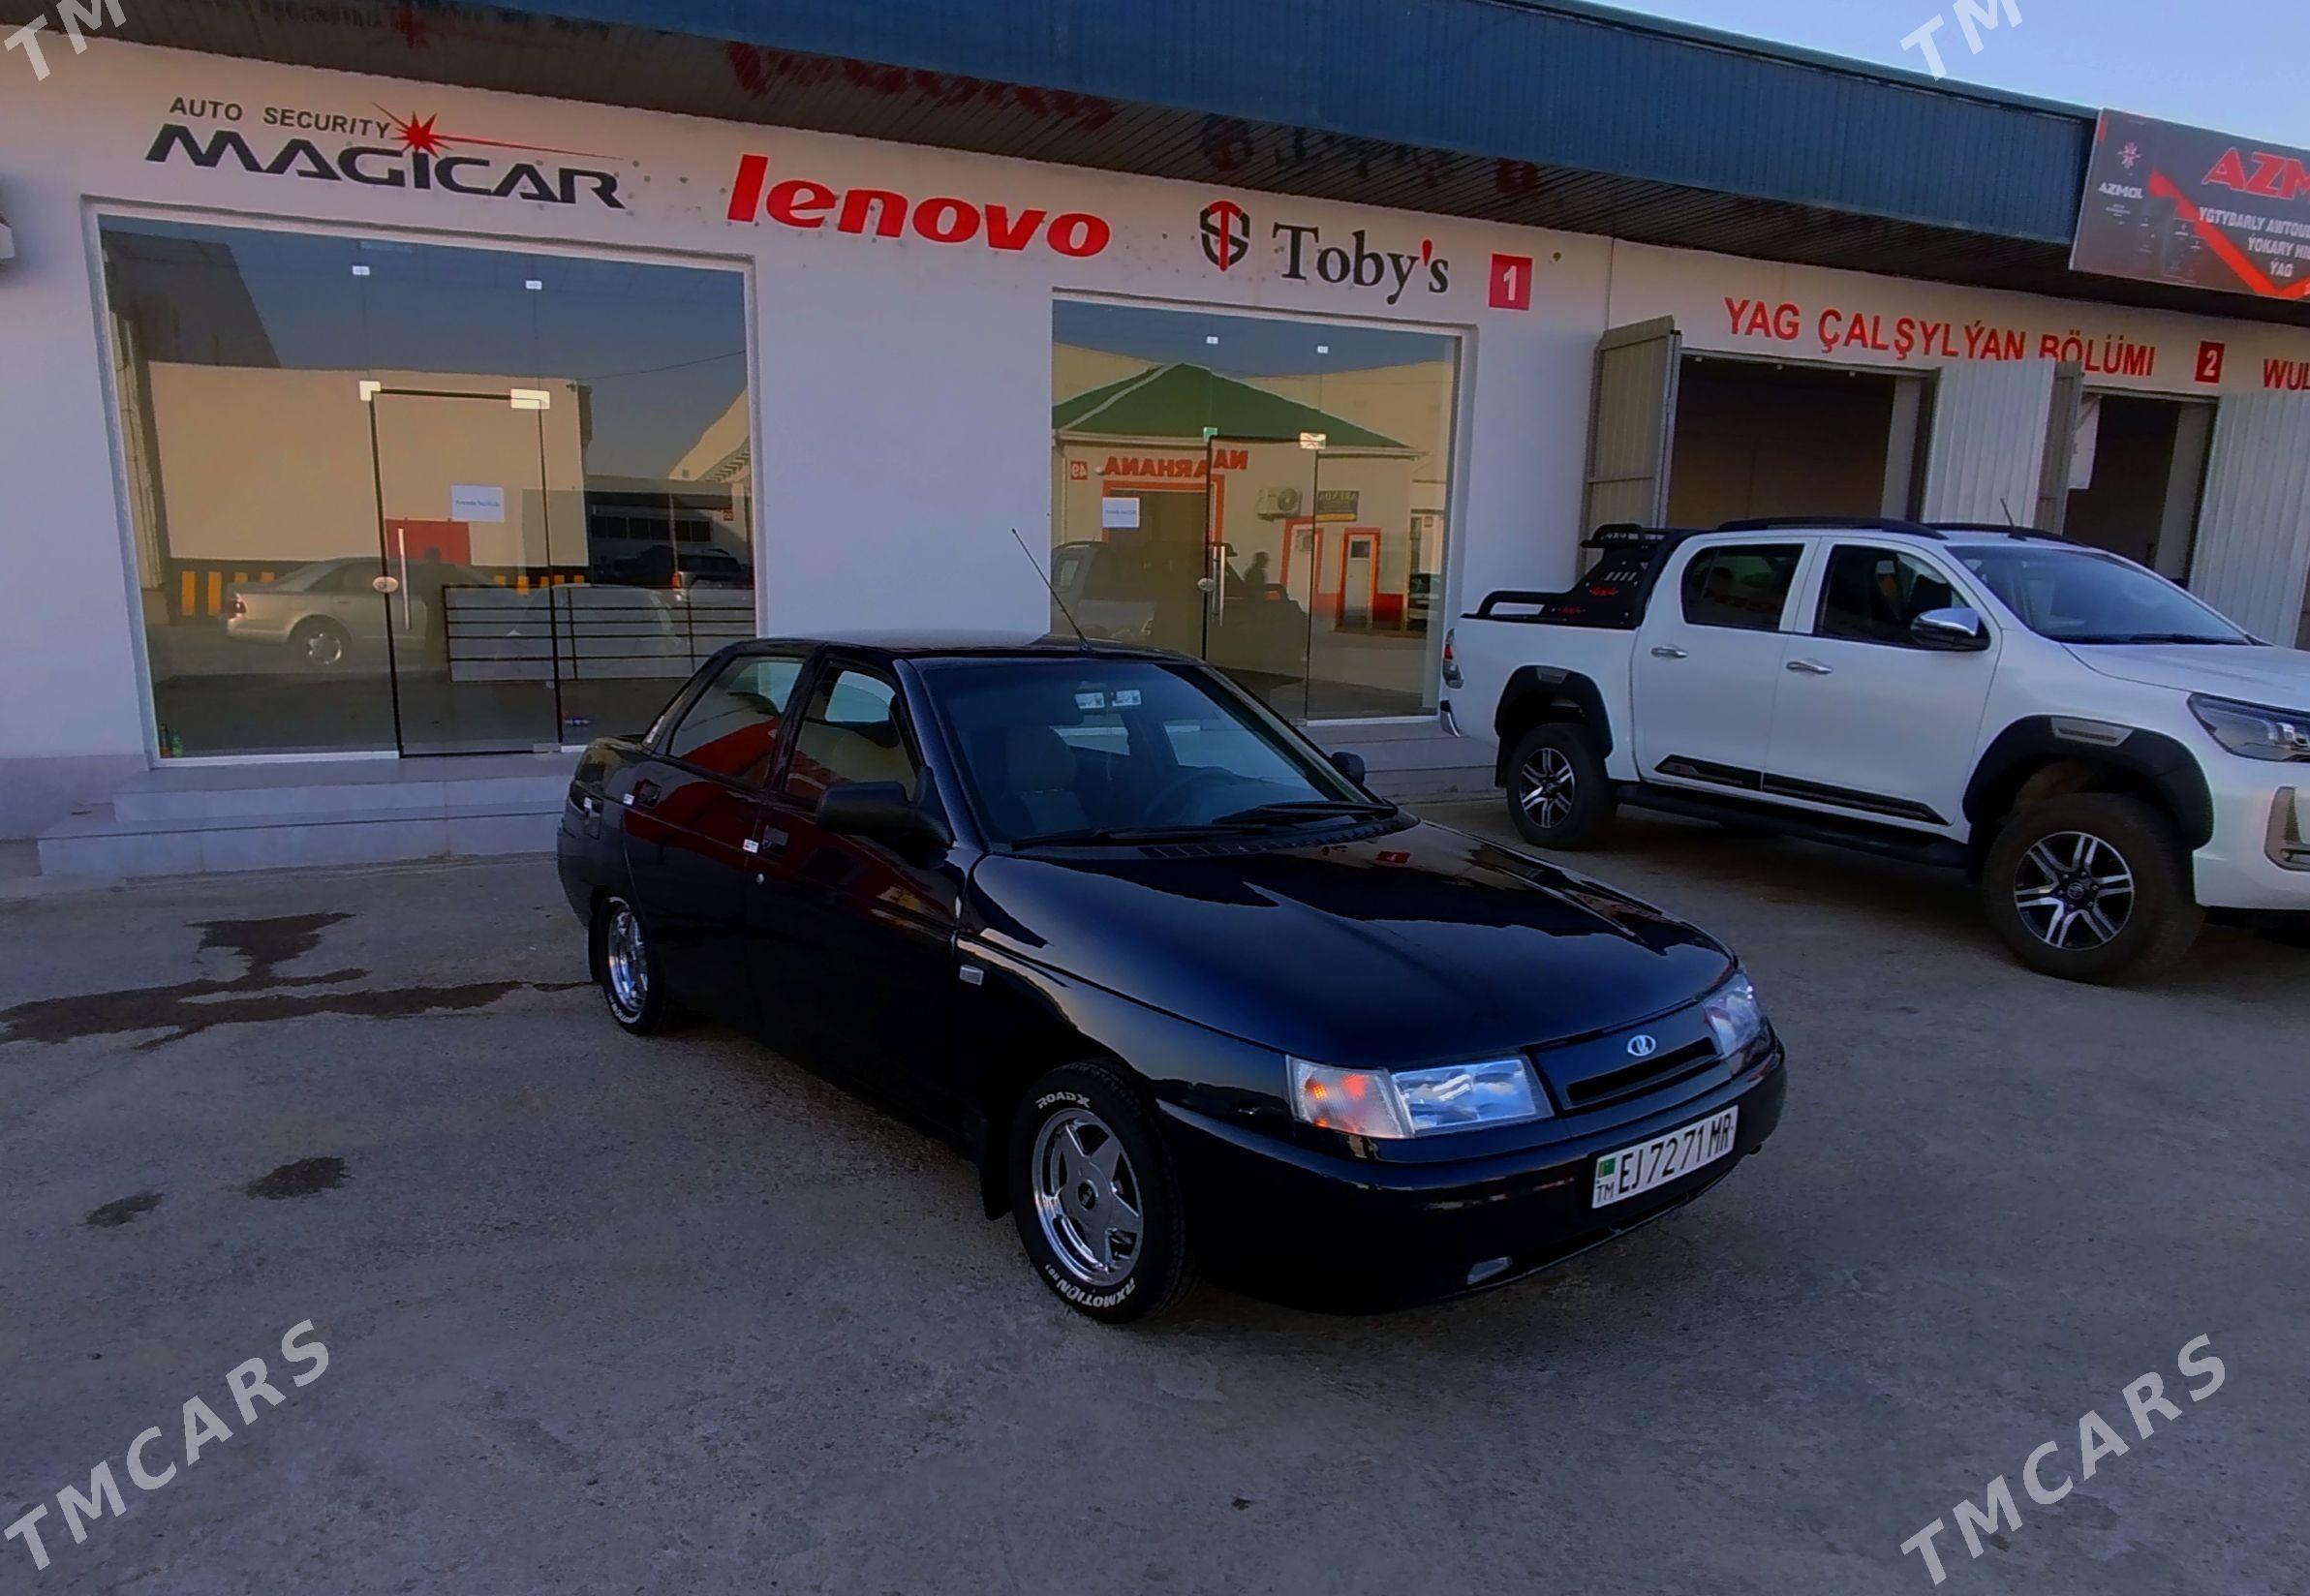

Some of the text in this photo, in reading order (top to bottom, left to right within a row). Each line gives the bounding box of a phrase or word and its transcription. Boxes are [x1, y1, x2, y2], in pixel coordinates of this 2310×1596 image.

[169, 97, 390, 138] AUTO SECURITY
[145, 123, 626, 209] MAGICAR
[2201, 147, 2310, 201] AZM
[726, 154, 1111, 257] lenovo
[2098, 182, 2143, 199] AZMOL
[2199, 206, 2265, 231] YGTYBARLY
[2248, 232, 2295, 257] ÝOKARY
[1272, 222, 1449, 305] Toby's
[2269, 258, 2294, 278] ÝAG
[1503, 264, 1518, 301] 1
[1724, 296, 1801, 340] YAG
[1818, 308, 2026, 361] ÇALŞYLÝAN
[2205, 350, 2218, 377] 2
[1035, 1091, 1091, 1109] ROADX
[1597, 1180, 1615, 1203] TM
